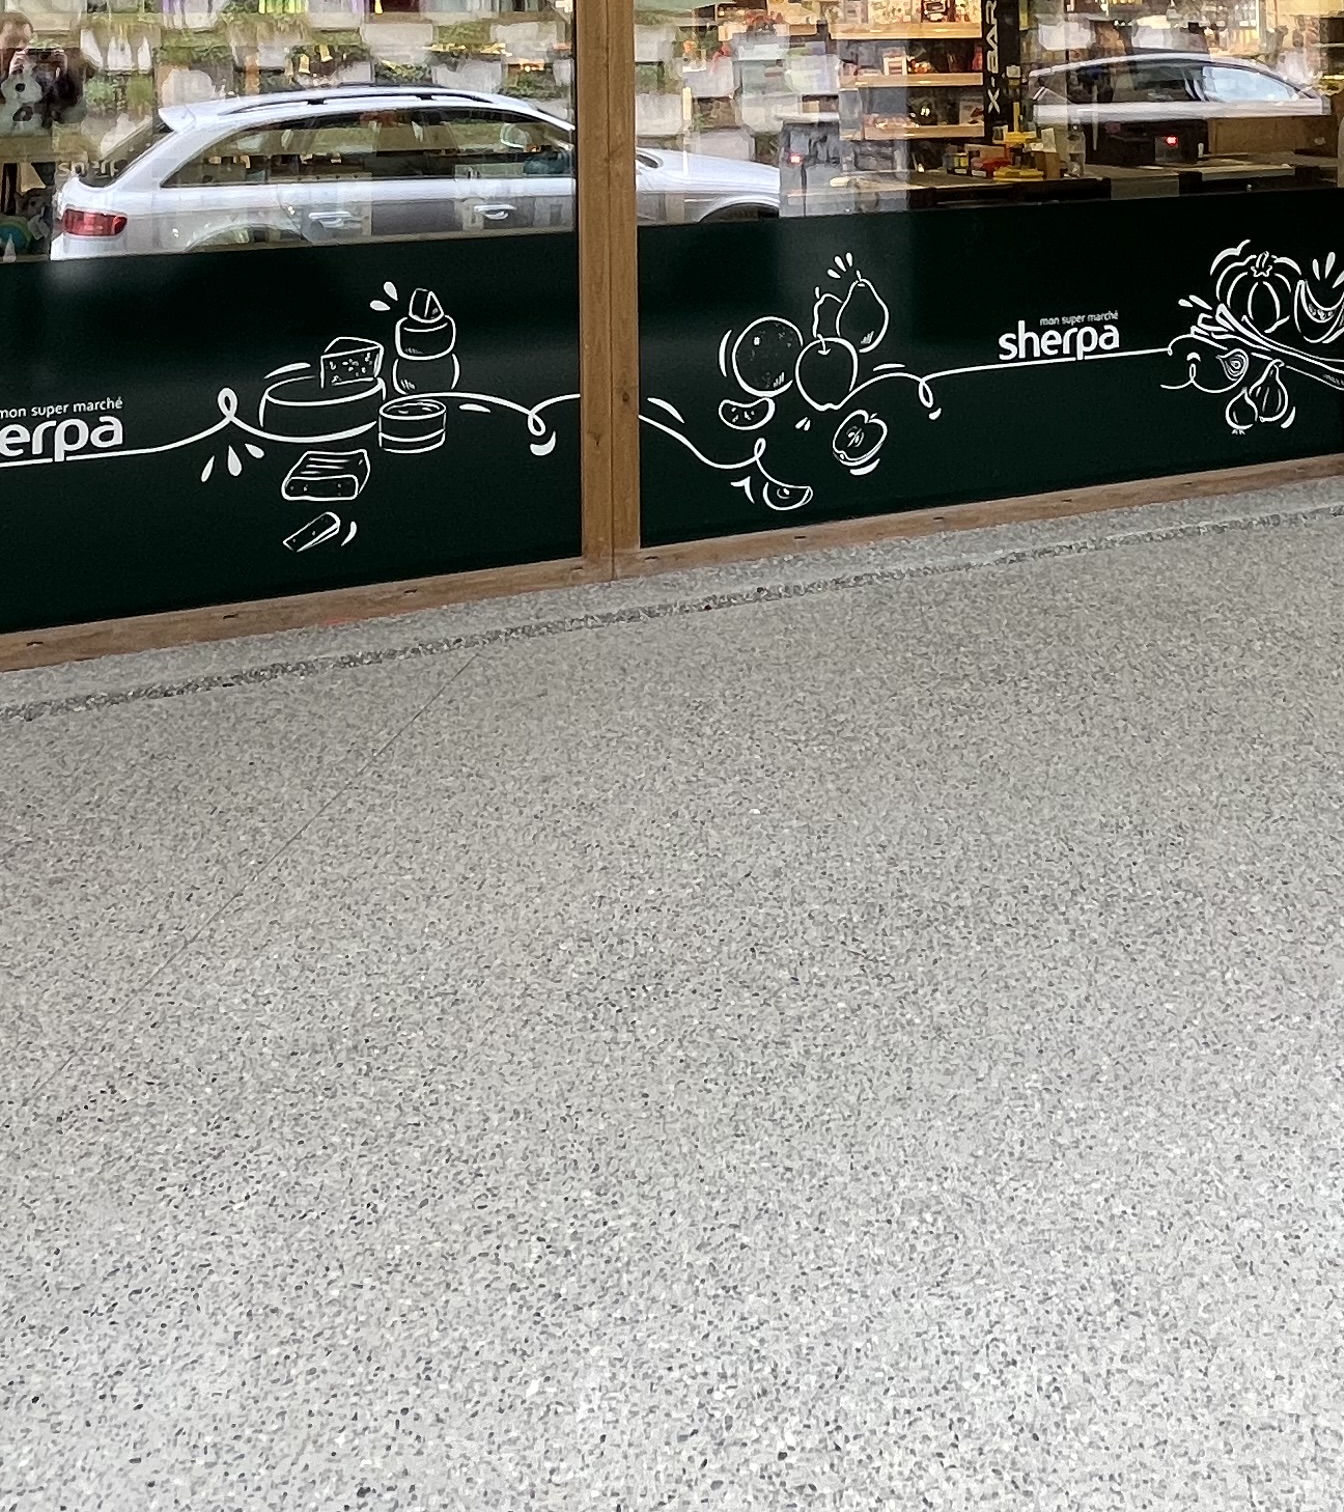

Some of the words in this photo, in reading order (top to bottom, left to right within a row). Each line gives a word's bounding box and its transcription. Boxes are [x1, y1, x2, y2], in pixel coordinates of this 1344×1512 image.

[985, 0, 1001, 115] X-BAR
[1039, 317, 1060, 326] mon
[1061, 314, 1086, 326] super
[1087, 310, 1119, 322] marché
[998, 320, 1120, 361] sherpa
[30, 403, 69, 419] super
[73, 396, 123, 413] marché
